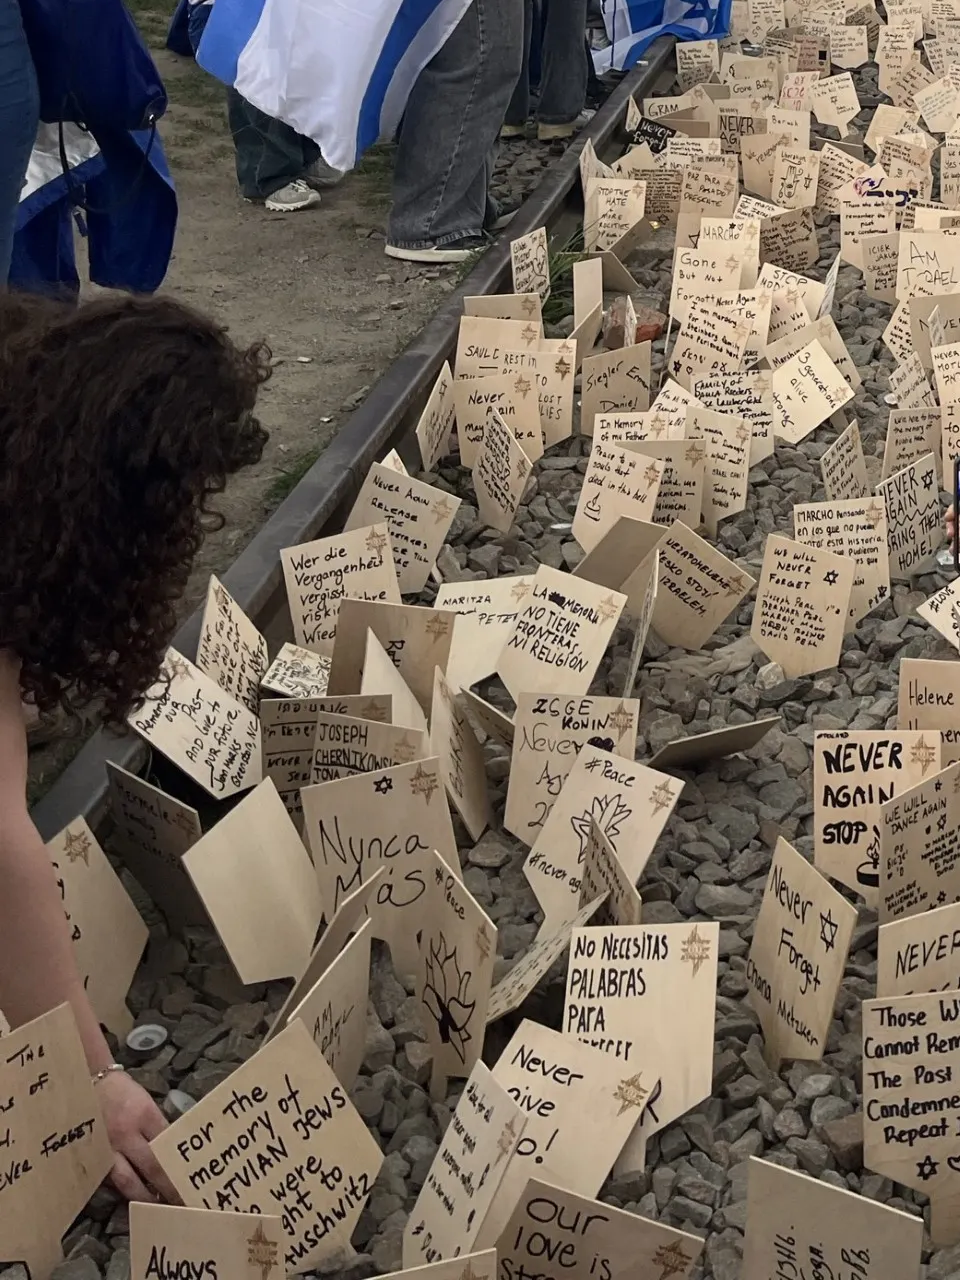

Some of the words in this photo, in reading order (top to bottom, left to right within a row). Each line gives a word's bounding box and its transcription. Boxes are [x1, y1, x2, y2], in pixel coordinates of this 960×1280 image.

[720, 116, 754, 134] NEVER
[606, 198, 627, 206] HATE
[703, 226, 740, 241] MARCHO
[681, 252, 717, 269] Gone
[679, 270, 696, 280] But
[705, 271, 724, 282] Not
[773, 269, 808, 285] STOP
[504, 354, 525, 366] REST
[934, 351, 960, 361] NEVER
[468, 390, 505, 405] Never
[538, 395, 563, 403] LOST
[599, 396, 638, 411] Daniel
[790, 378, 808, 403] alive
[947, 406, 954, 416] I
[600, 420, 612, 429] In
[614, 419, 644, 431] Memory
[797, 509, 834, 523] MARCHO
[797, 528, 808, 536] en
[826, 525, 840, 536] que
[844, 524, 854, 532] no
[290, 555, 320, 571] Wer
[324, 546, 348, 560] die
[899, 536, 933, 571] HOME!
[294, 556, 385, 592] Vergangenheit
[443, 595, 492, 605] MARITZA
[532, 584, 548, 600] LA
[928, 585, 955, 613] #LOVE
[522, 606, 546, 621] NO
[549, 610, 580, 638] TIENE
[508, 635, 530, 650] NI
[909, 678, 955, 706] Helene
[319, 723, 369, 748] JOSEPH
[561, 714, 610, 731] KONIN
[822, 740, 903, 774] NEVER
[584, 757, 636, 788] #Peace
[822, 782, 894, 808] AGAIN
[885, 807, 900, 825] WE
[904, 794, 927, 814] WILL
[892, 812, 918, 835] DANCE
[922, 797, 947, 821] AGAIN
[319, 815, 430, 866] Nunca
[822, 821, 868, 845] STOP
[435, 867, 466, 921] #Peace
[769, 865, 813, 925] Never
[574, 934, 596, 959] NO
[601, 931, 669, 961] NECESITAS
[778, 927, 821, 995] Forget
[570, 967, 646, 999] PALABRAS
[568, 1004, 606, 1034] PARA
[871, 1006, 928, 1028] Those
[864, 1034, 921, 1060] Cannot
[510, 1043, 584, 1087] Never
[867, 1071, 903, 1090] The
[913, 1067, 952, 1086] Past
[222, 1085, 268, 1121] The
[41, 1118, 95, 1157] FORGET
[188, 1110, 275, 1190] memory
[277, 1073, 301, 1115] of
[883, 1116, 950, 1147] Repeat
[270, 1155, 323, 1203] were
[321, 1165, 343, 1191] to
[526, 1197, 610, 1235] Our
[144, 1246, 217, 1280] Always
[514, 1225, 578, 1269] love
[589, 1253, 612, 1280] is
